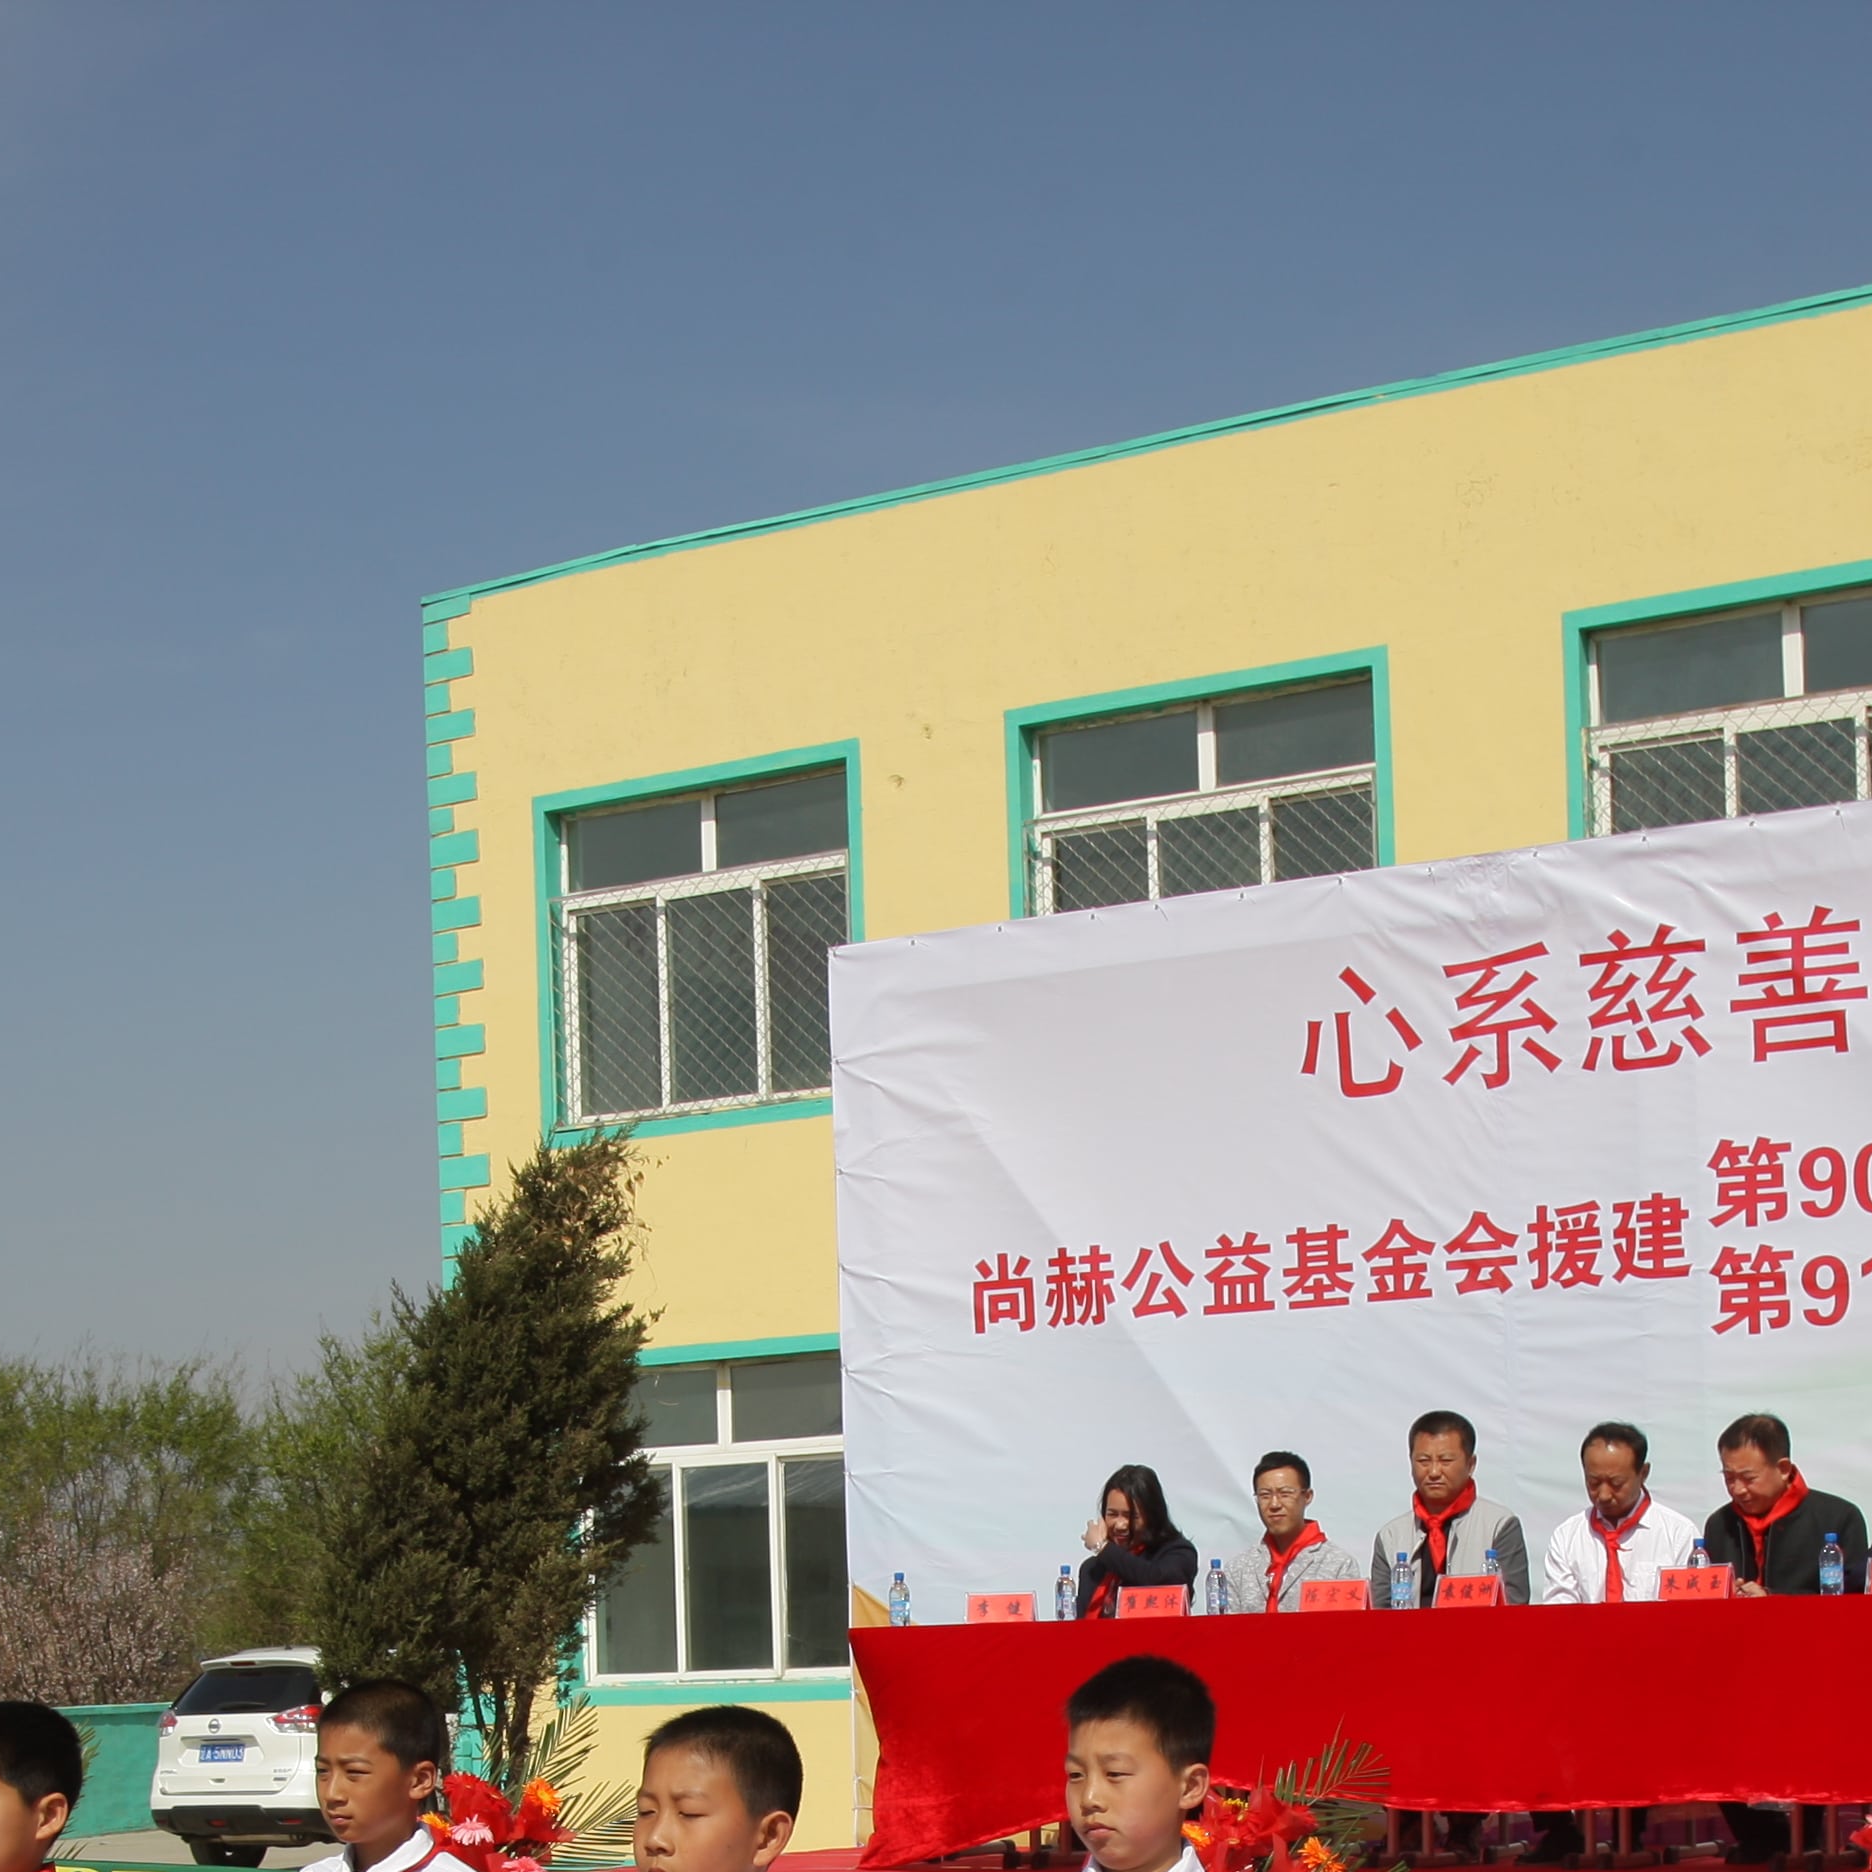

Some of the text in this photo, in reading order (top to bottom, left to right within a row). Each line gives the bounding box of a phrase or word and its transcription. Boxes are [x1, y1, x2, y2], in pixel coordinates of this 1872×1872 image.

[1301, 905, 1869, 1099] 心系慈善
[971, 1192, 1692, 1336] 尚赫公益基金会援建
